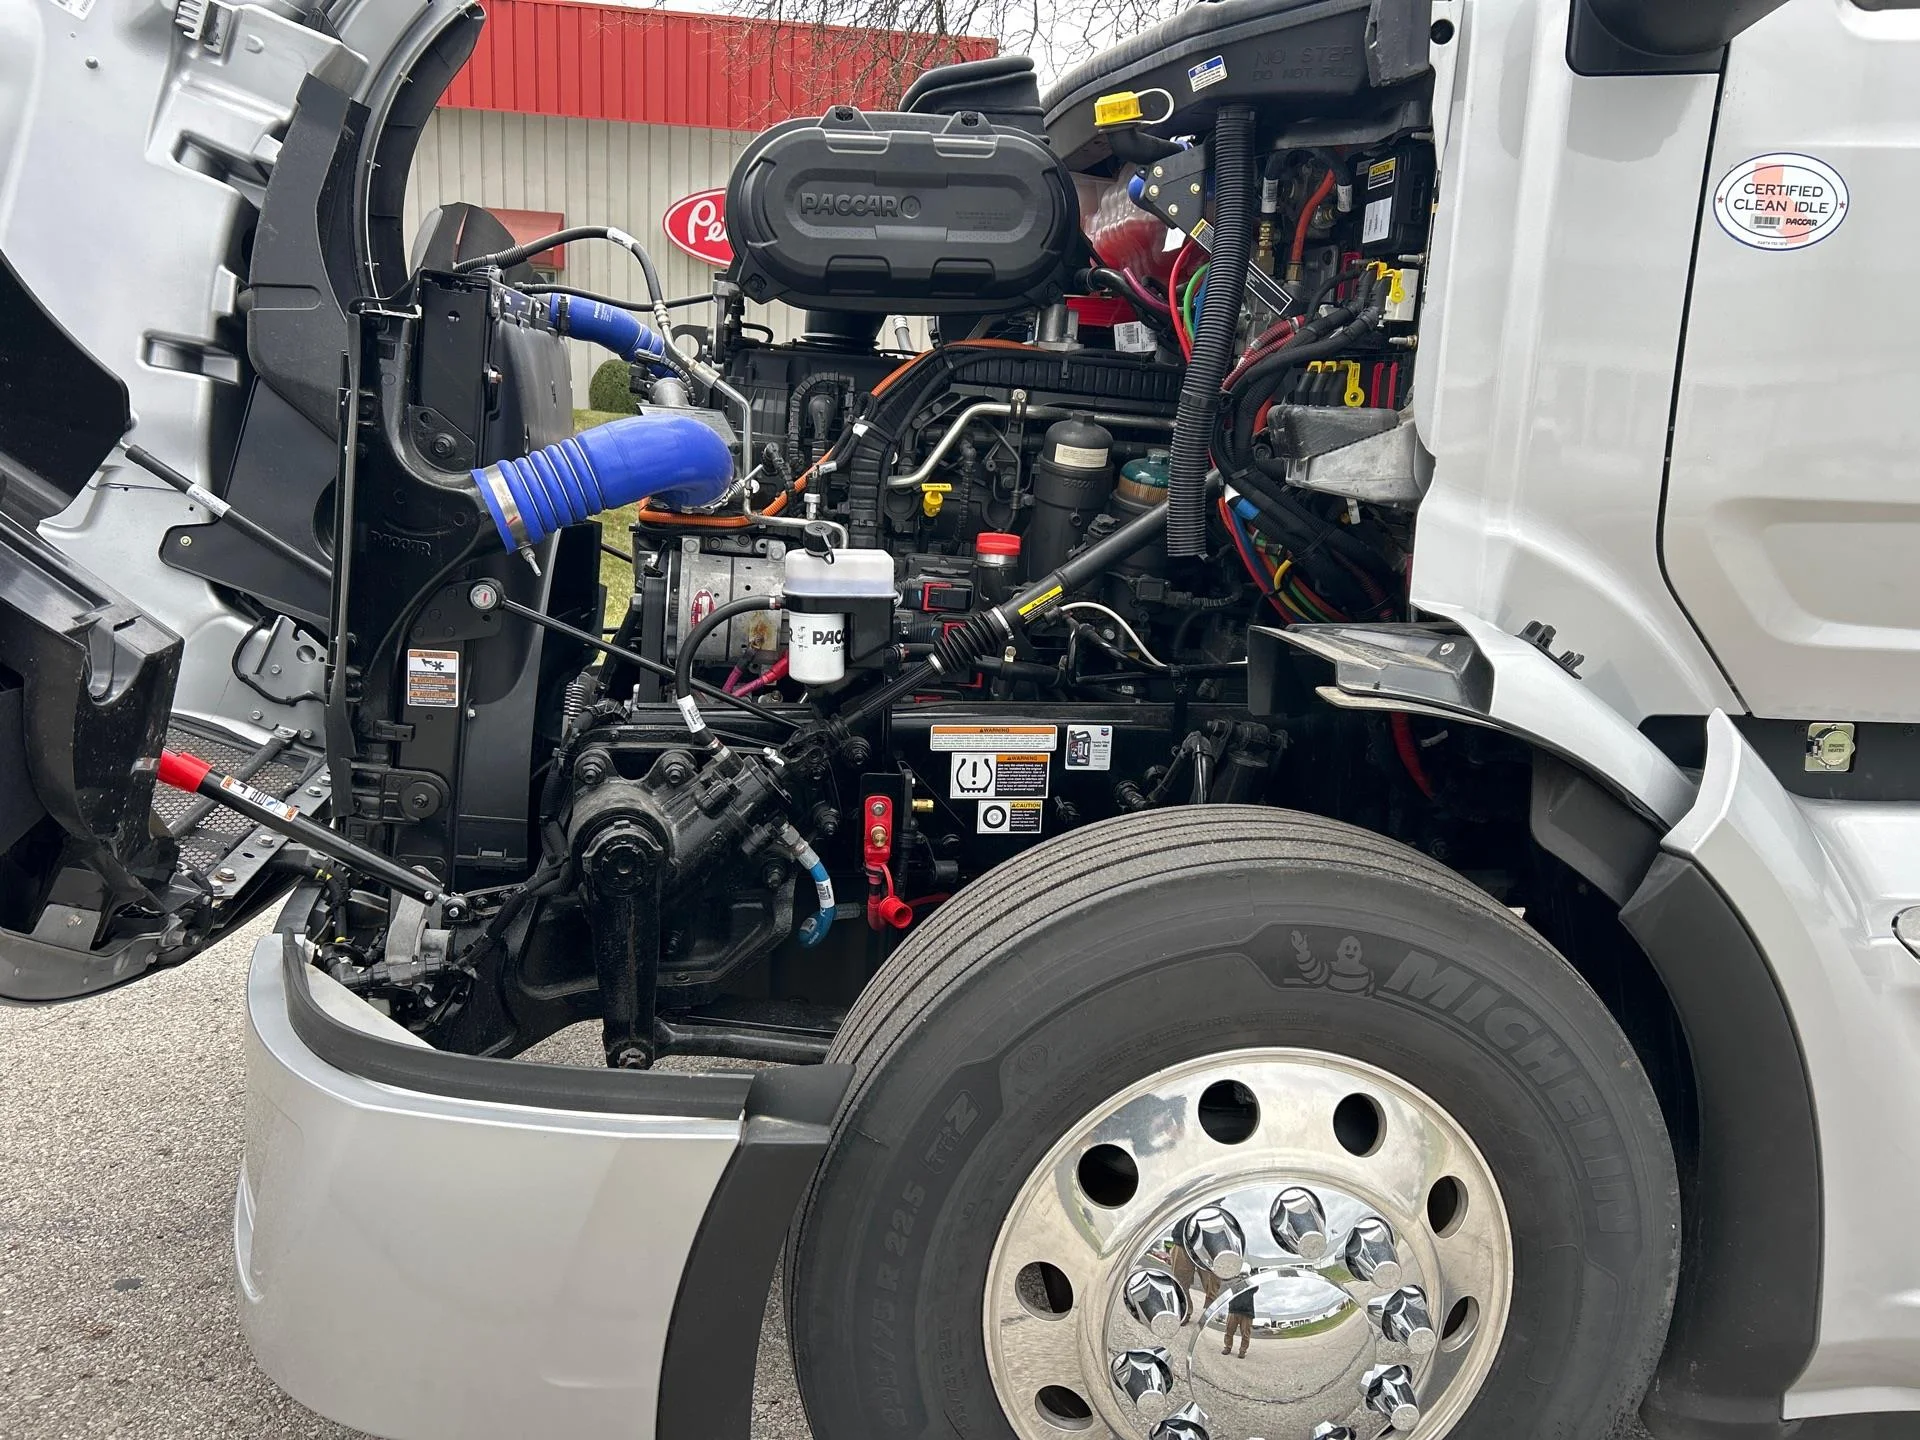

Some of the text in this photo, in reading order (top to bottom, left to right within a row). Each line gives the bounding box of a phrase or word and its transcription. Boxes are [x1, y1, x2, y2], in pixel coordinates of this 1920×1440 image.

[1255, 44, 1353, 65] NO STEP
[1743, 183, 1823, 198] CERTIFIED
[800, 192, 899, 218] PACCAR
[1733, 199, 1829, 214] CLEAN IDLE
[1785, 217, 1818, 227] PACCAR
[1383, 950, 1638, 1234] MICHELIN
[886, 1180, 926, 1257] 22.5
